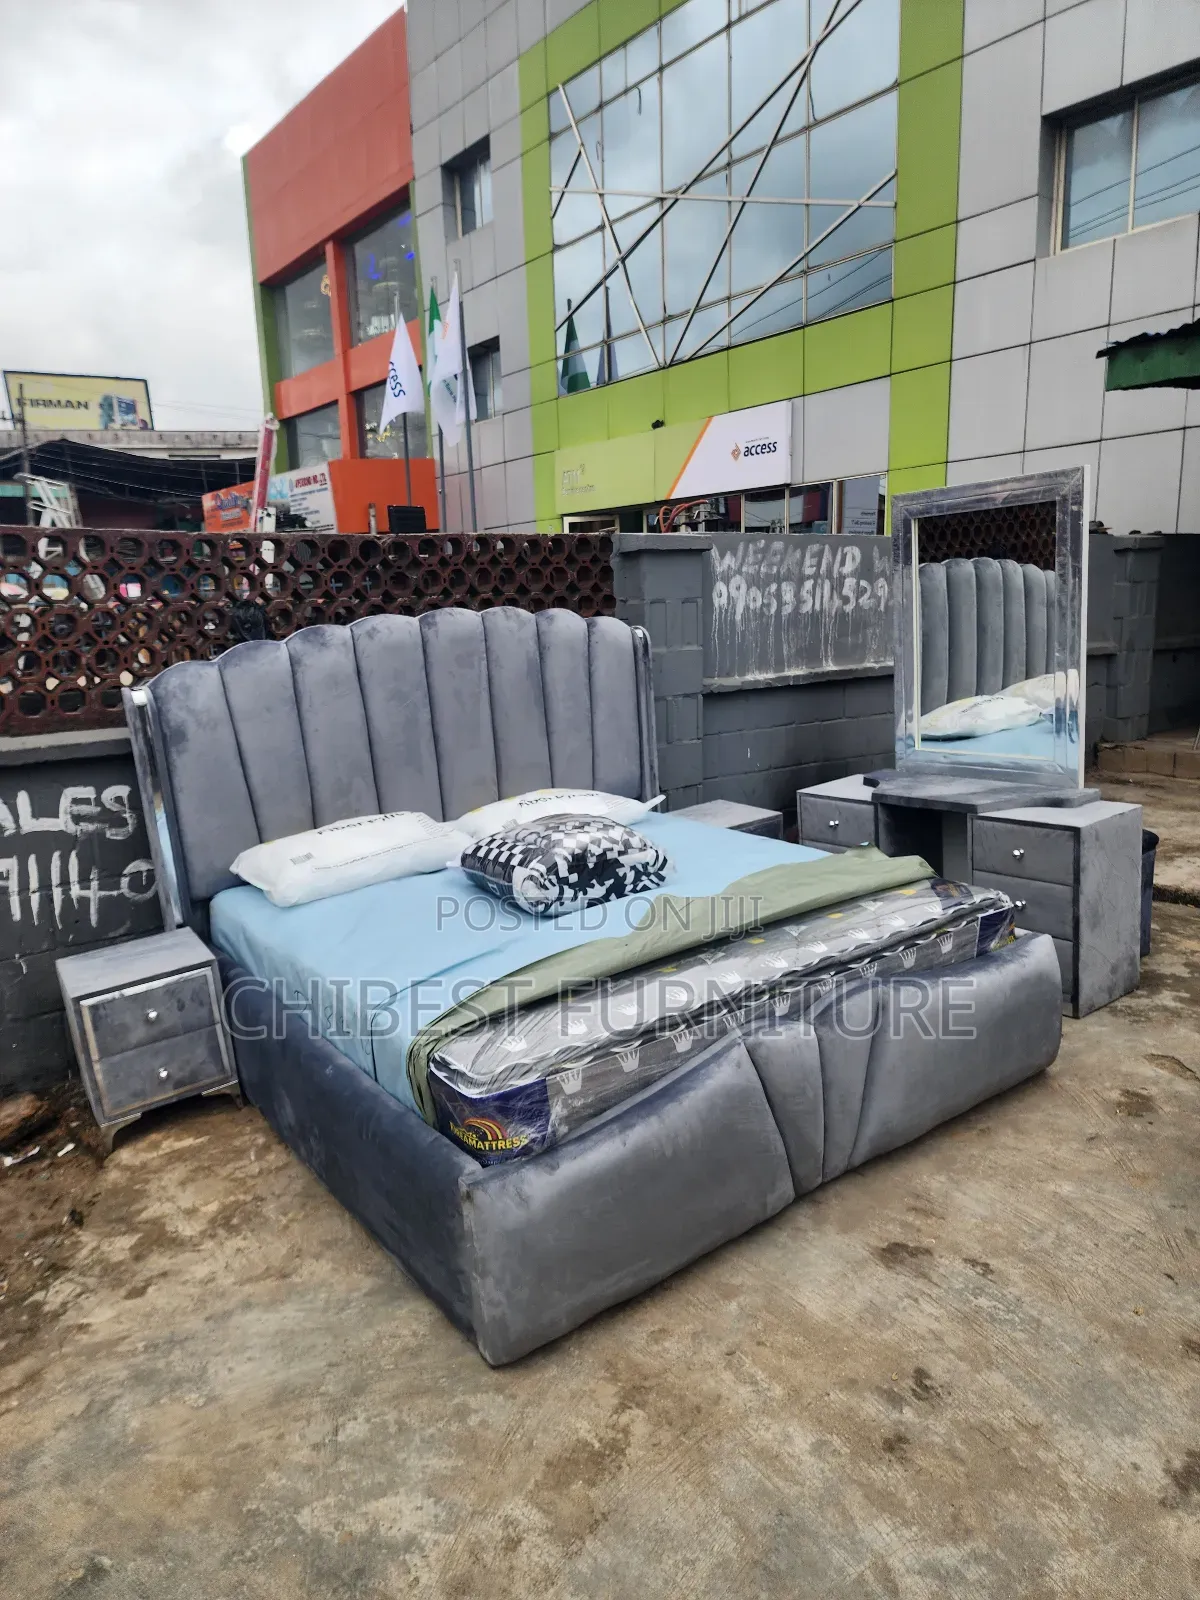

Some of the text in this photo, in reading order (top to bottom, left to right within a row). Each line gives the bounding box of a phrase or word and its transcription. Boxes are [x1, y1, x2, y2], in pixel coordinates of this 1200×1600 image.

[16, 397, 90, 410] FIRMAN
[743, 441, 778, 457] access
[711, 540, 861, 577] WEEKEND
